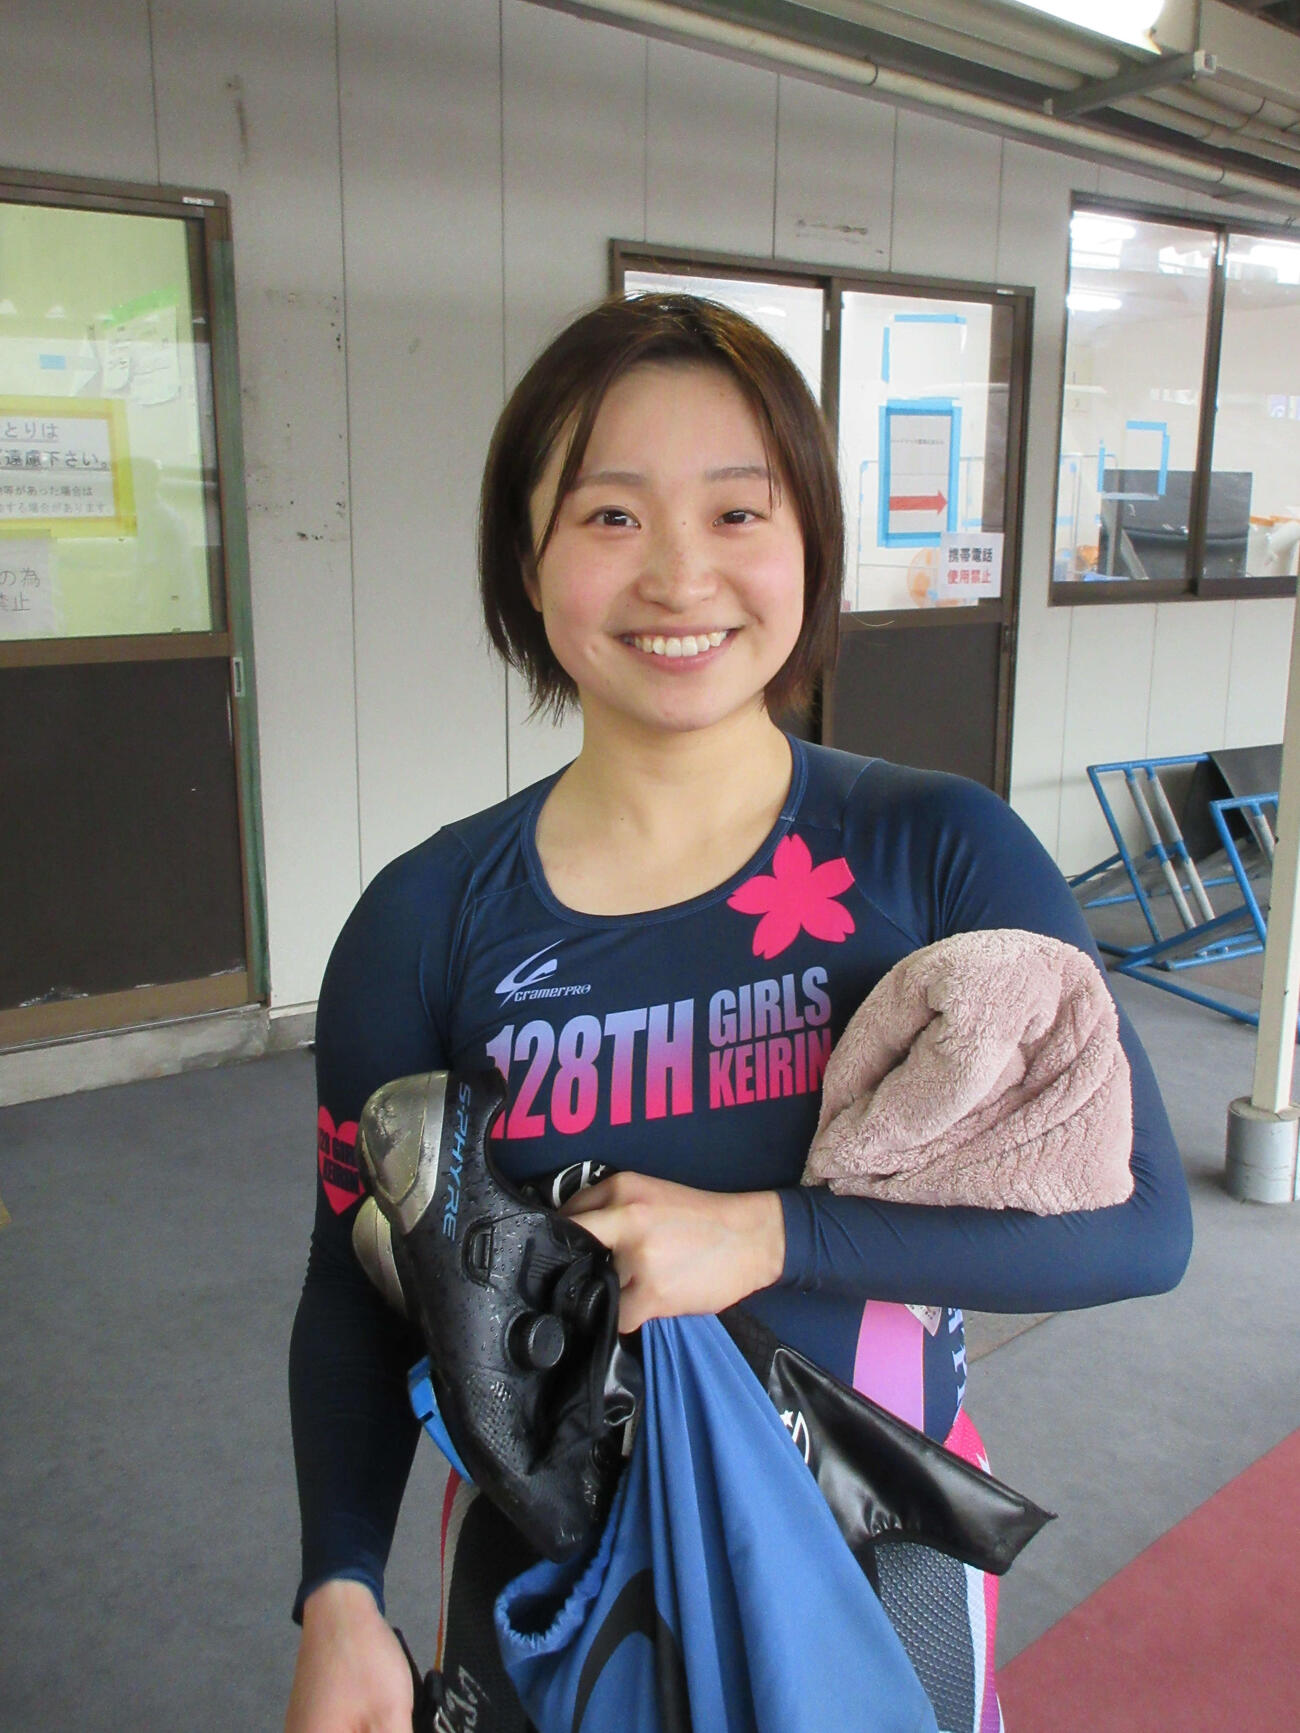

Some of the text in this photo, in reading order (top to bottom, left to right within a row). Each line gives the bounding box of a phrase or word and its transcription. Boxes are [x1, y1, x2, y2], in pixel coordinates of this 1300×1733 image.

[947, 569, 991, 584] 使用禁止
[948, 547, 993, 563] 携帯電話
[708, 966, 832, 1048] GIRLS
[485, 998, 695, 1140] 128TH
[708, 1027, 833, 1110] KEIRIN
